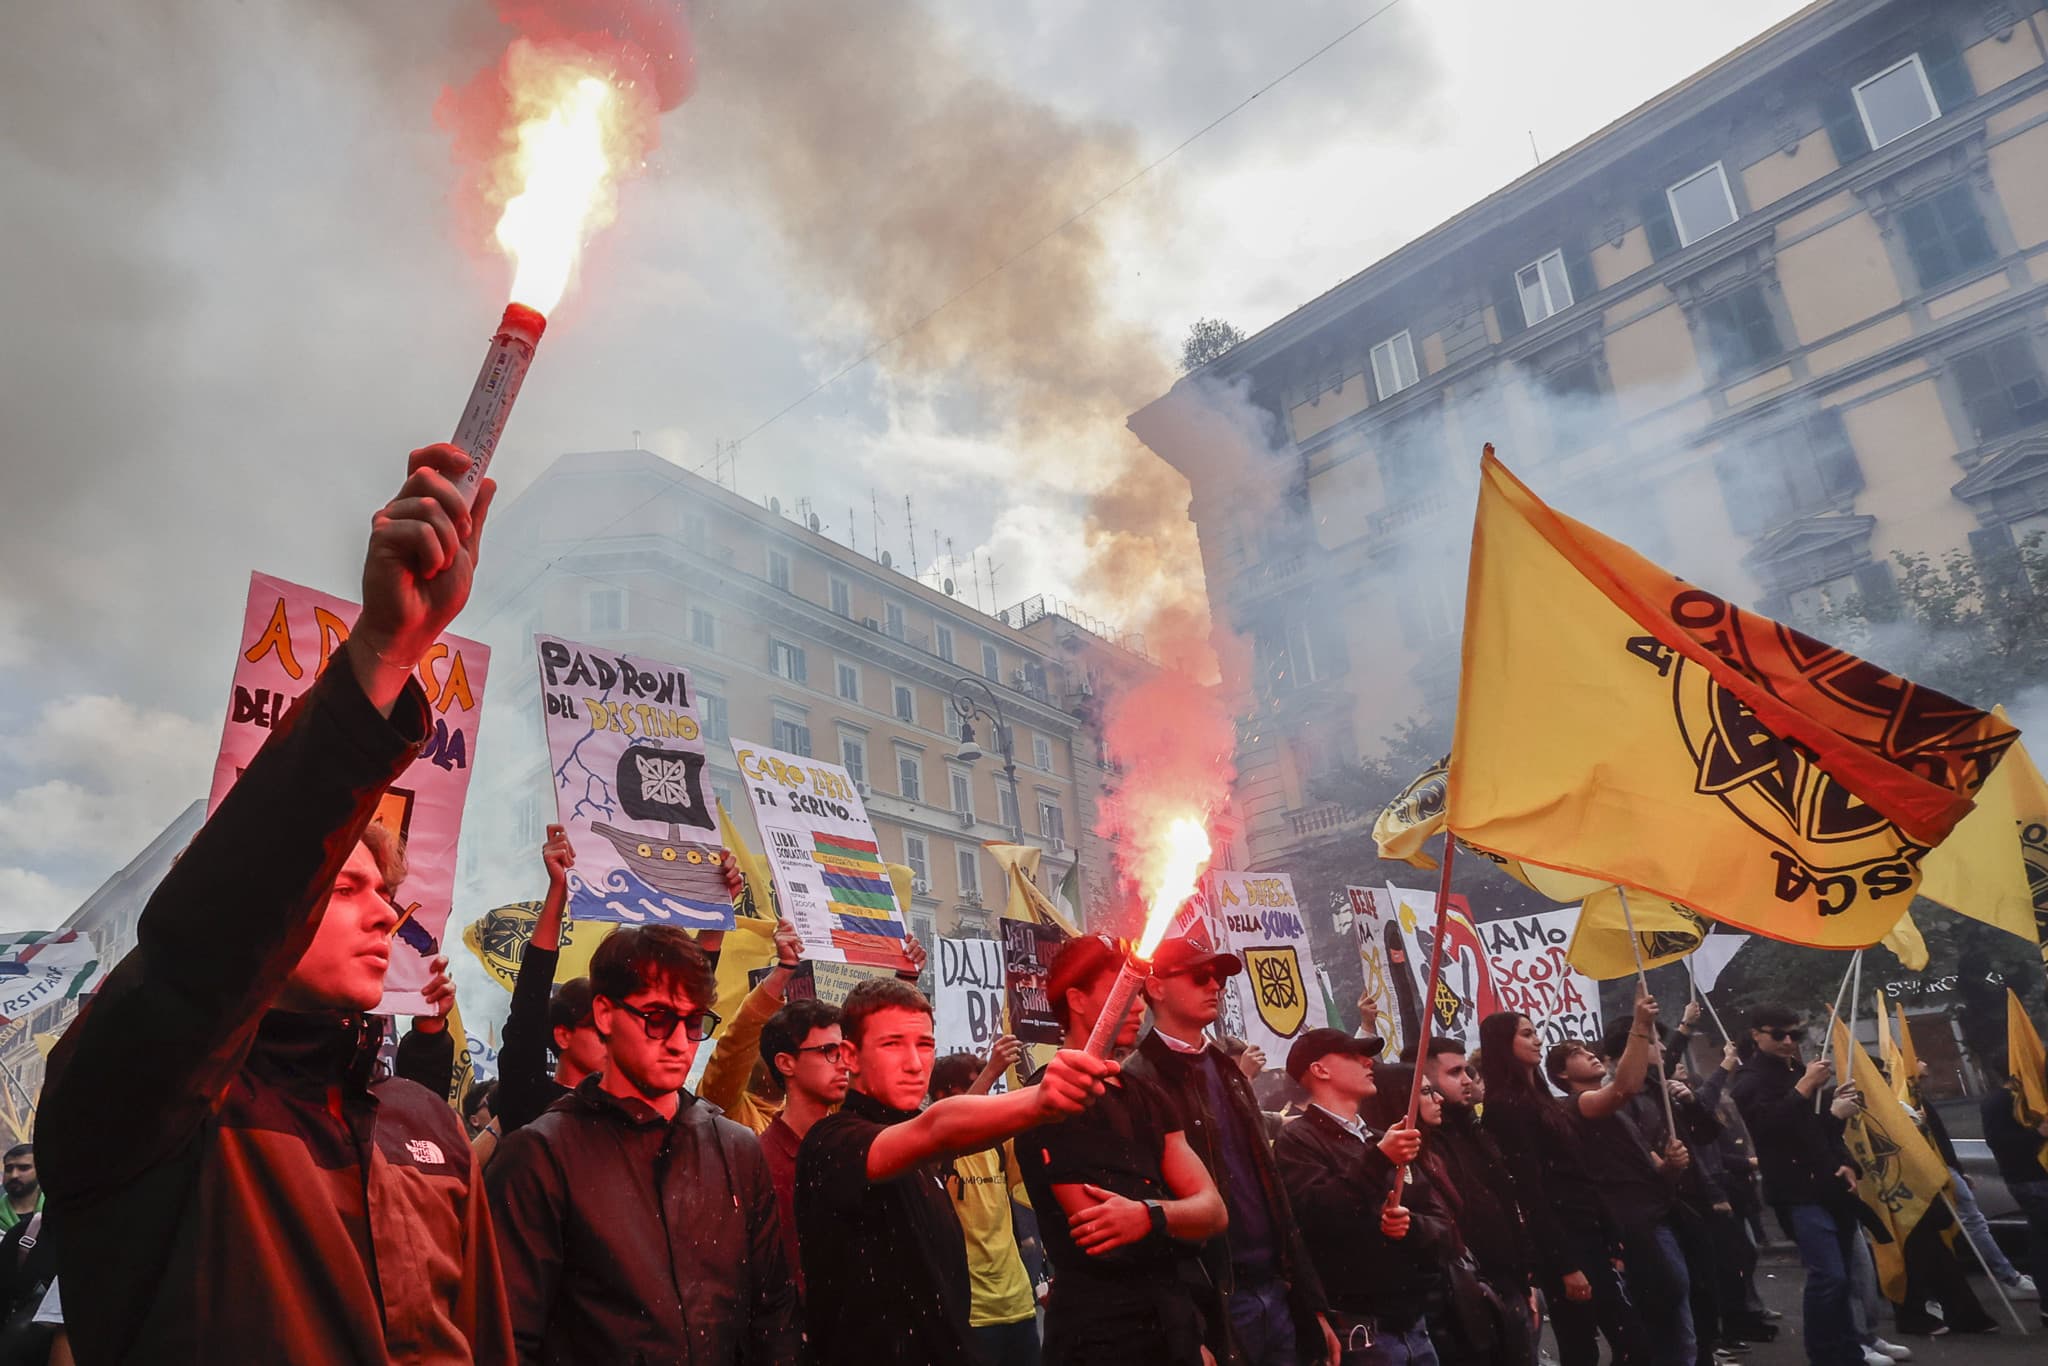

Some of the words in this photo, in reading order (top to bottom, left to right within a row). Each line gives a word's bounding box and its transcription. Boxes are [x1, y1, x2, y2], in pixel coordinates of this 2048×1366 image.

[244, 597, 303, 680] A
[314, 606, 475, 715] DSA
[541, 641, 690, 708] PADRONI
[546, 692, 579, 719] DEL
[582, 697, 699, 740] DESTINO
[737, 749, 806, 790] CARO
[807, 766, 853, 804] LIBRI
[754, 787, 778, 807] TI
[771, 831, 800, 848] LIBRI
[1222, 880, 1240, 907] A
[1243, 879, 1295, 908] DIFESA
[1227, 913, 1263, 933] DELLA
[815, 961, 839, 975] Chiude
[841, 964, 848, 976] le
[940, 938, 1005, 990] DALL
[824, 974, 832, 986] le
